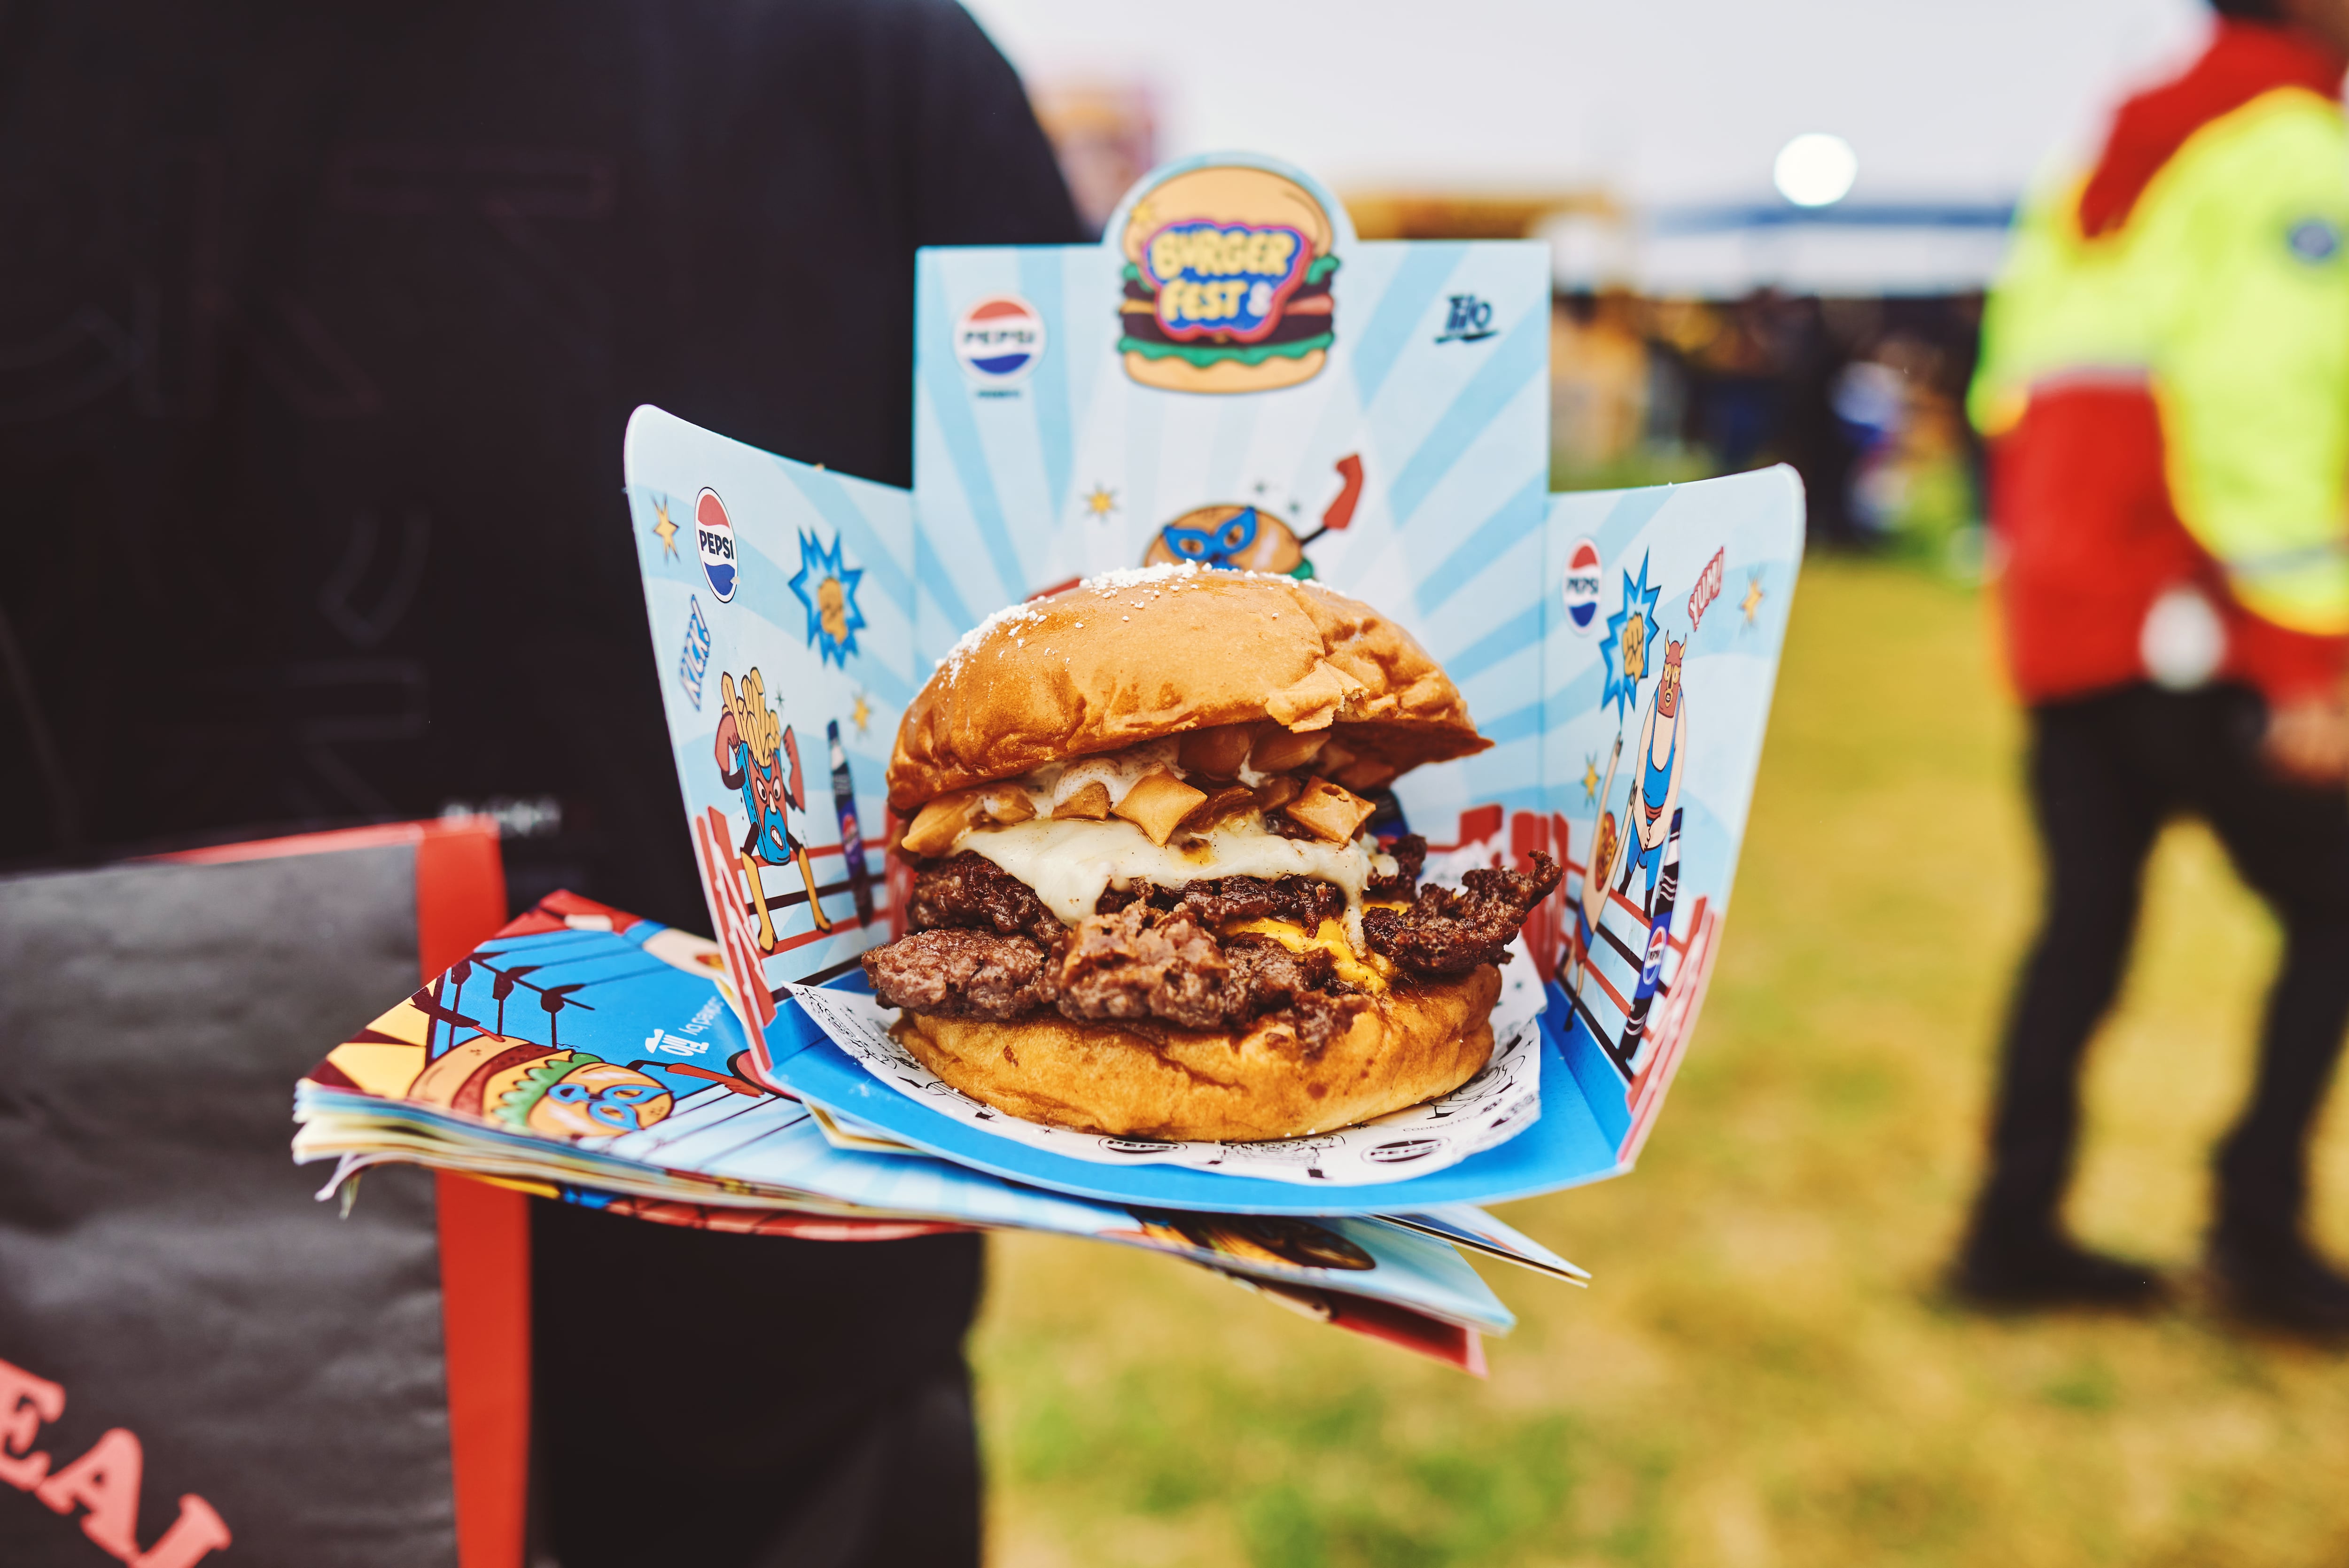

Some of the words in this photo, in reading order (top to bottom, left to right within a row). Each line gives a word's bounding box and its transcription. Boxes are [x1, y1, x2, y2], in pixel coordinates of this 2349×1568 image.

[1152, 229, 1295, 280] BURGER
[1159, 279, 1248, 322] FEST
[699, 529, 734, 559] PEPSI
[1567, 577, 1599, 594] PEPSI
[1689, 551, 1723, 626] YUM!
[680, 595, 710, 711] KICK!
[678, 1023, 709, 1035] by
